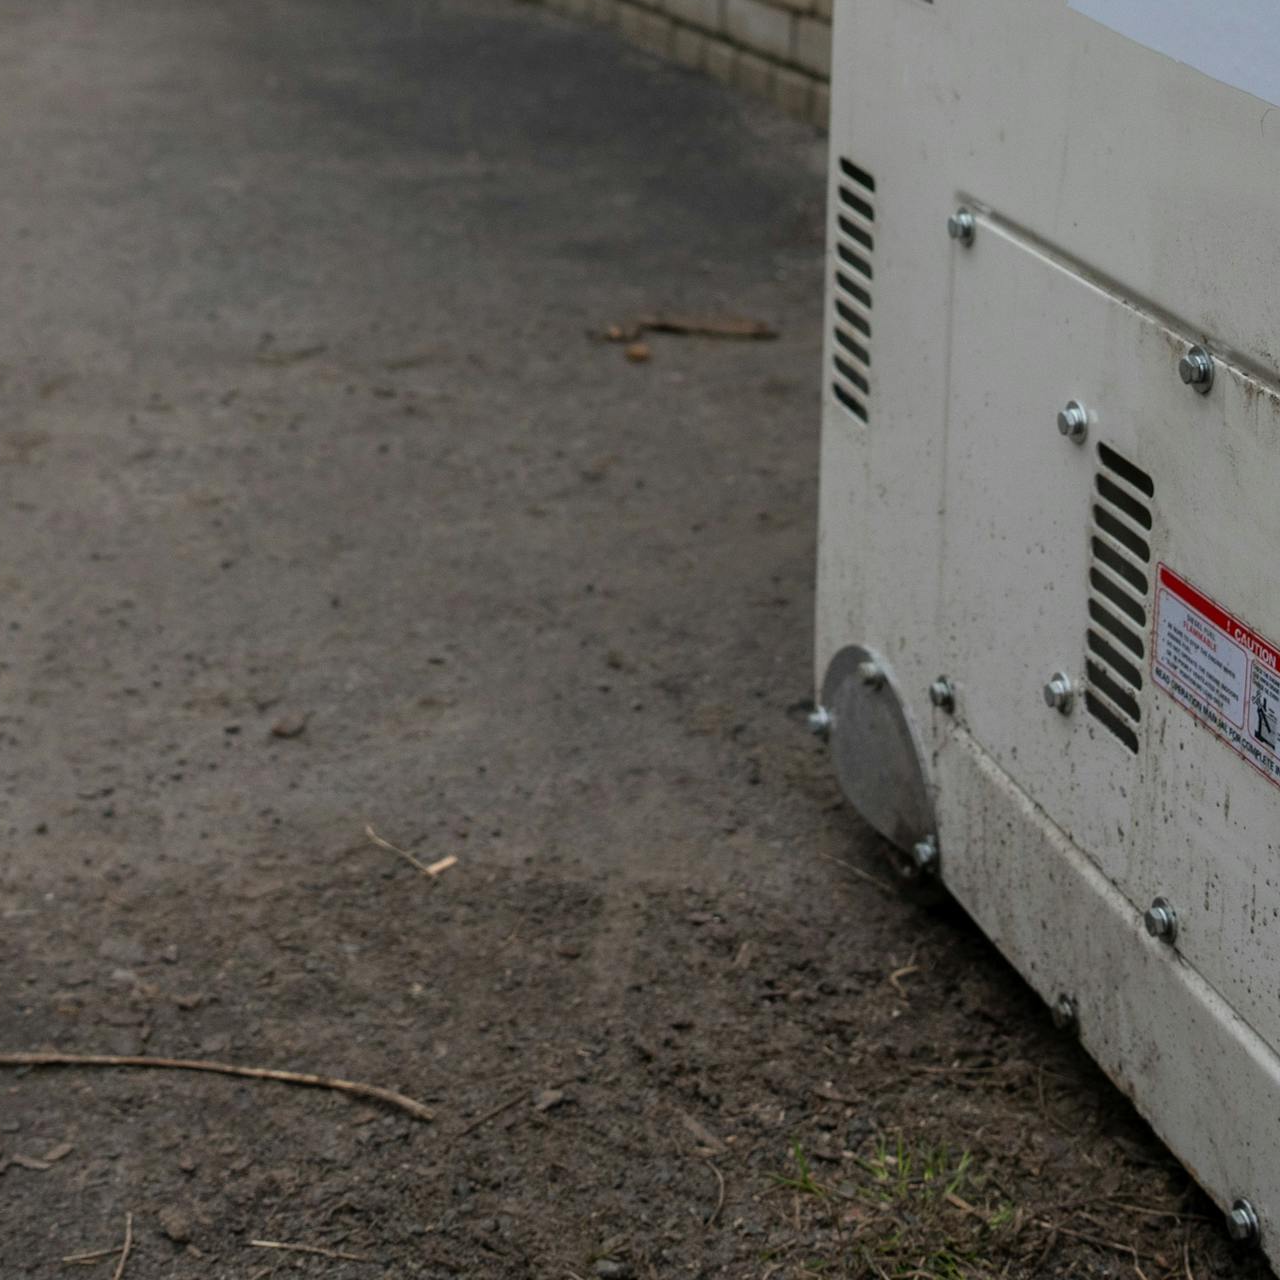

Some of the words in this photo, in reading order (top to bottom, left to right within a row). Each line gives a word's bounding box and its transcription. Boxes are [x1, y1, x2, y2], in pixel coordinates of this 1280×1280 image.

[1183, 620, 1216, 652] FLAMMABLE
[1234, 626, 1276, 669] CAUTION
[1155, 665, 1169, 685] READ
[1171, 678, 1201, 712] OPERATION
[1202, 704, 1227, 734] MANUAL
[1228, 726, 1240, 745] FOR
[1241, 736, 1274, 772] COMPLETE
